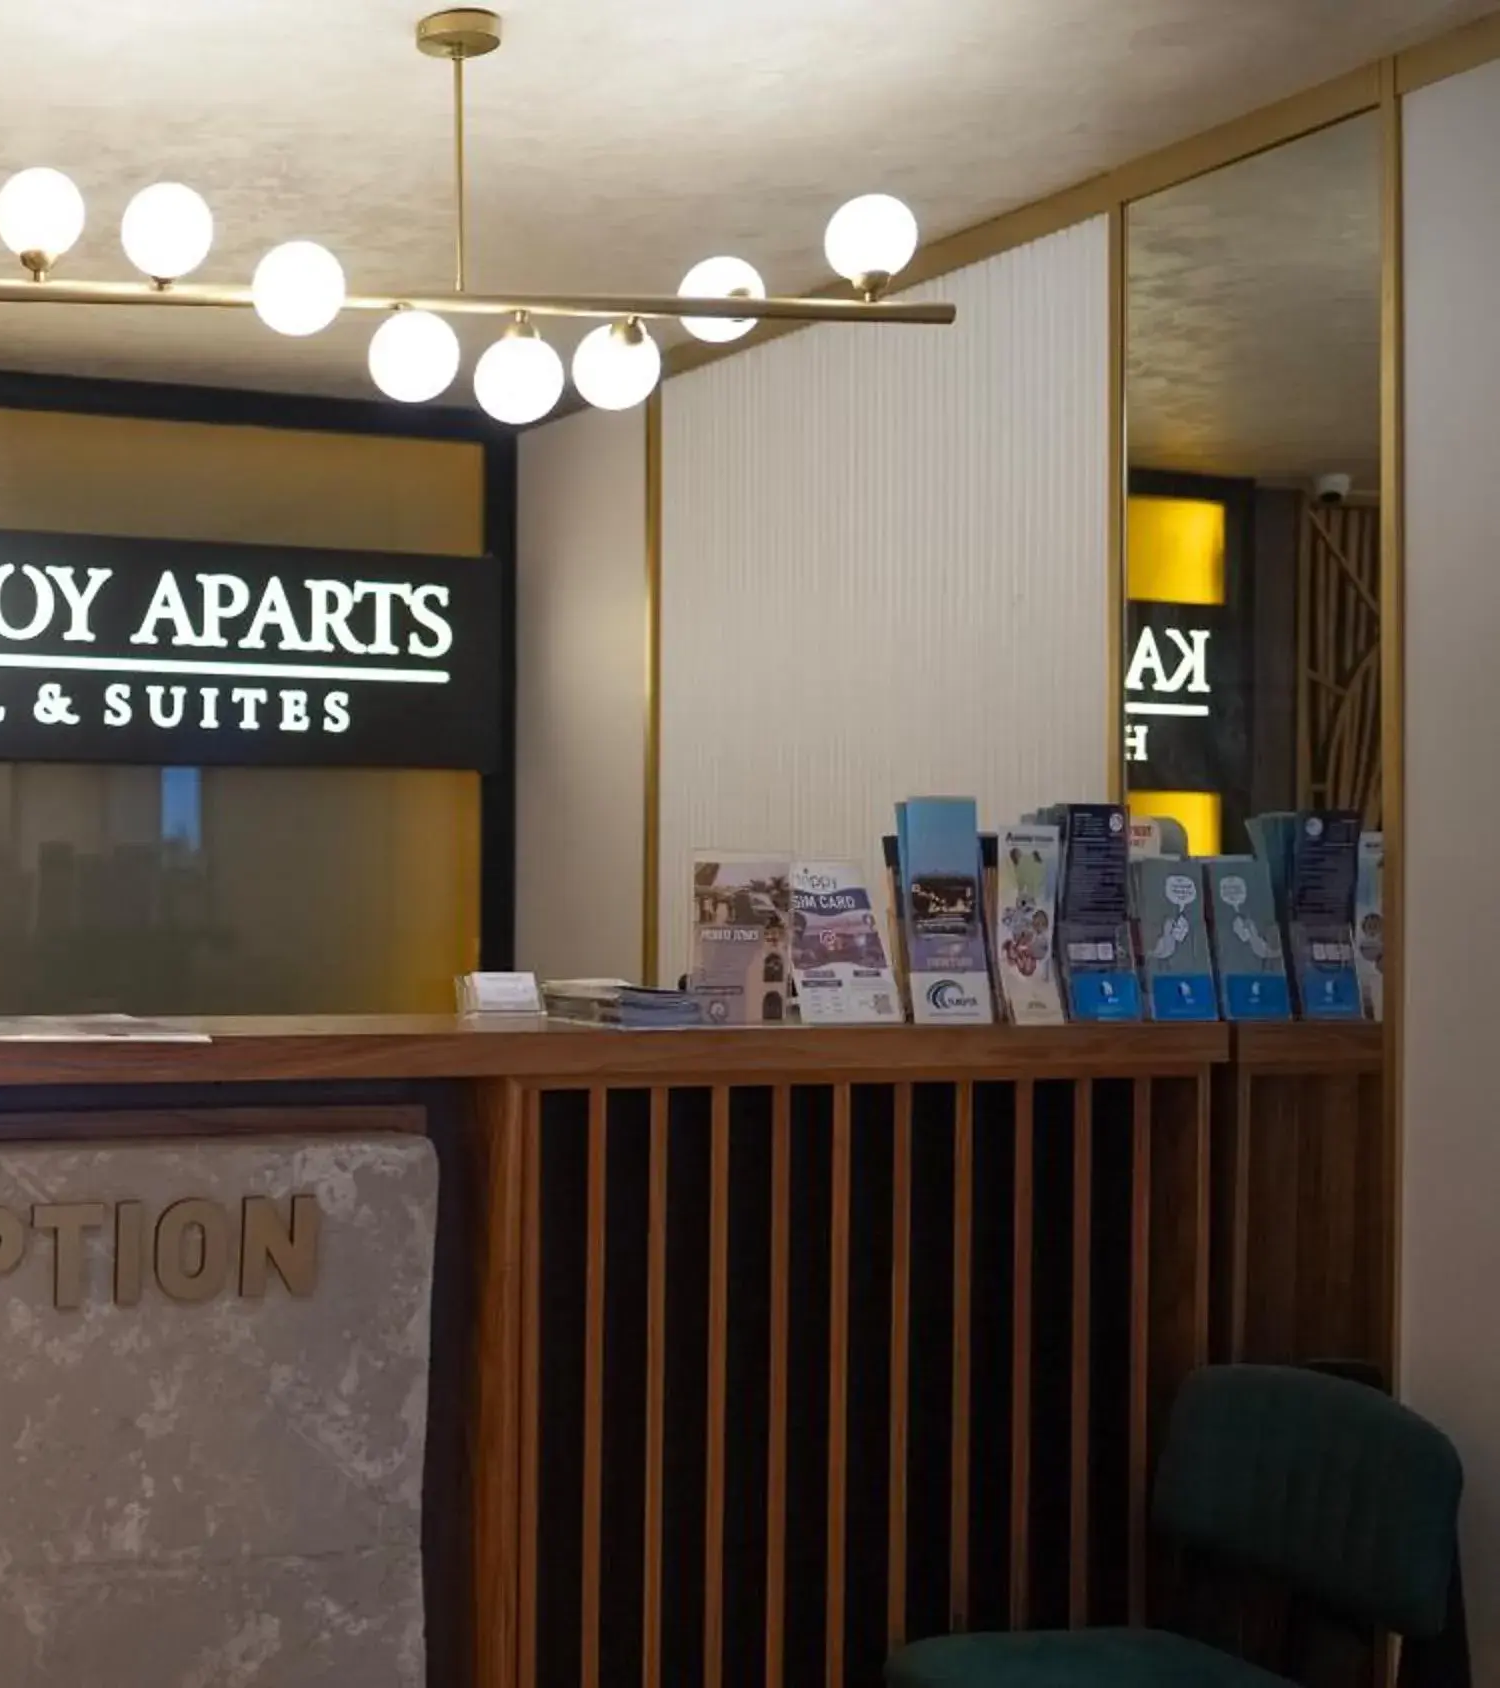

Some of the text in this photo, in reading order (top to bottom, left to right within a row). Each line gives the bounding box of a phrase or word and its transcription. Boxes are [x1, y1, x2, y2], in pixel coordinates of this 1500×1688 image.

[130, 571, 452, 657] APARTS
[34, 683, 80, 724] &
[104, 684, 350, 732] SUITES
[819, 895, 856, 909] CARD
